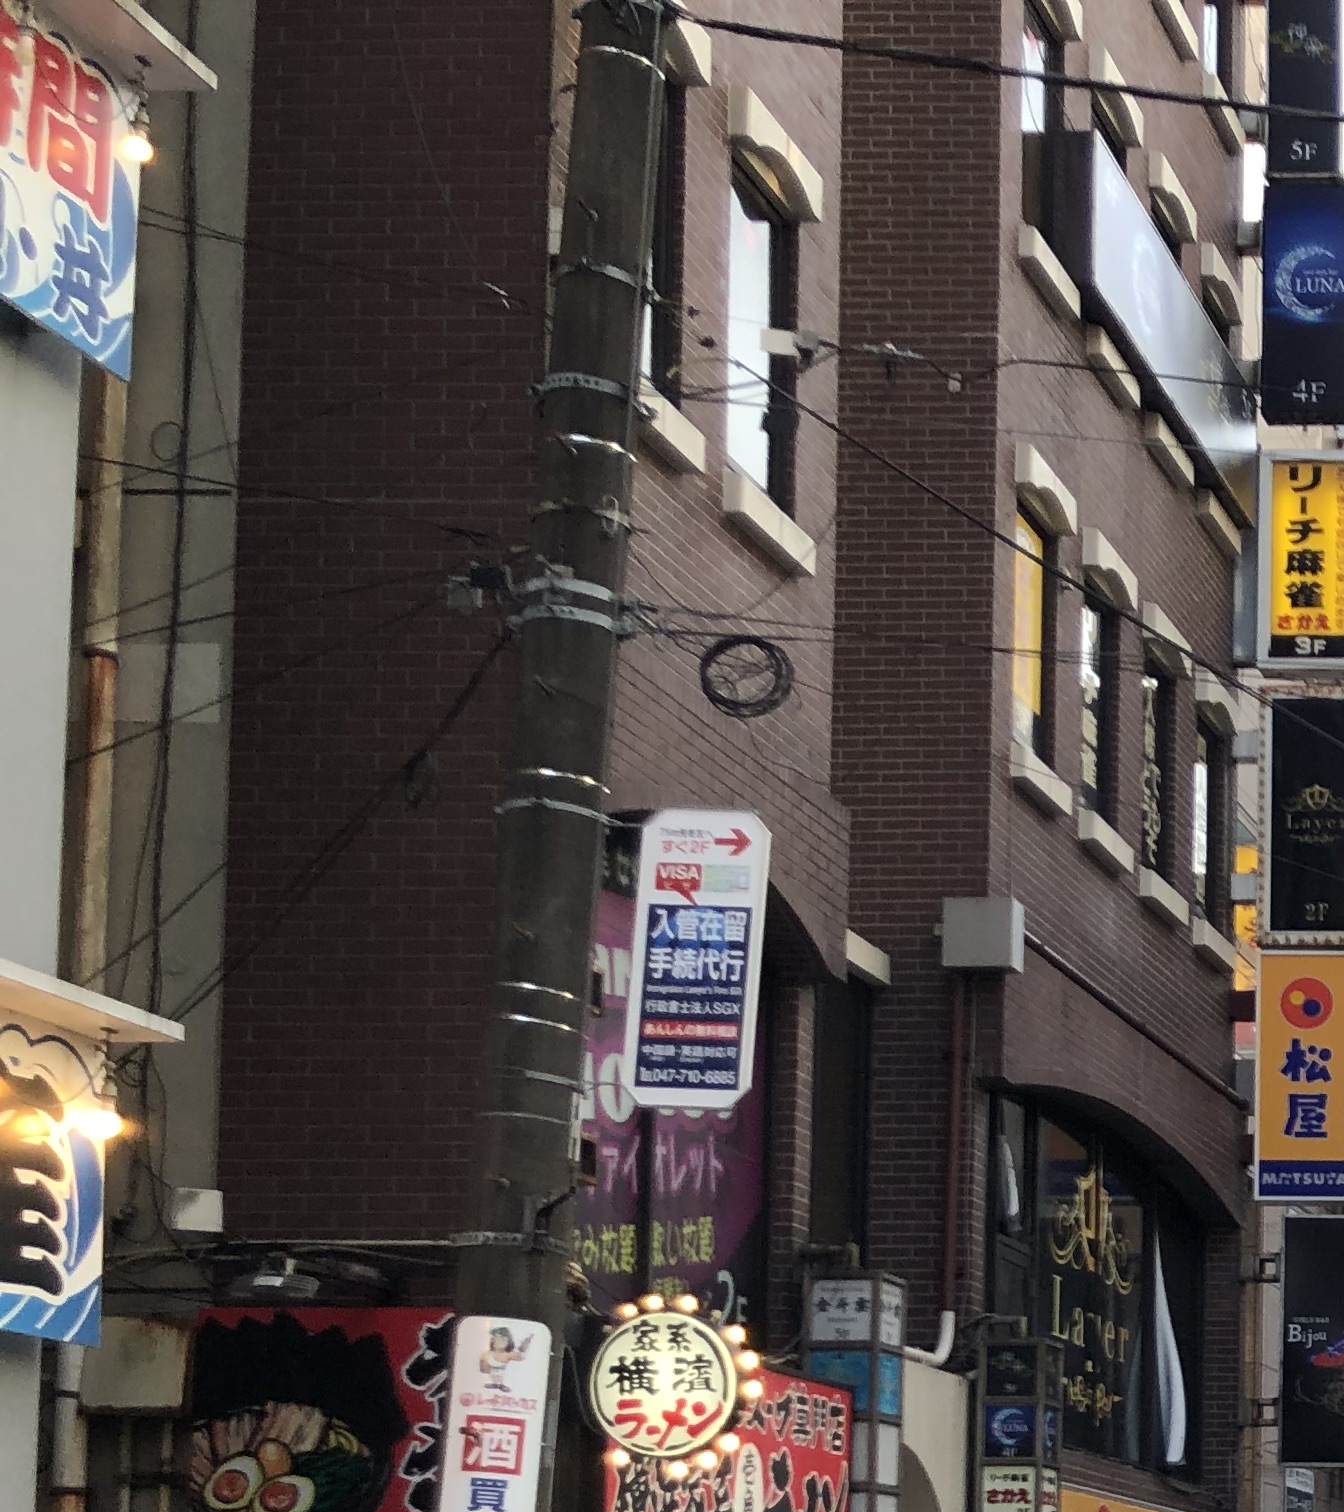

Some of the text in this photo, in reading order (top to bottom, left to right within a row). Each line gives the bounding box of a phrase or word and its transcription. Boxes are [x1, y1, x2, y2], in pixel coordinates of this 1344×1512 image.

[1290, 140, 1318, 162] 5F
[1293, 379, 1327, 403] 4F
[1286, 465, 1325, 608] リーチ麻雀
[1294, 636, 1327, 655] 3F
[660, 865, 700, 880] VISA
[650, 907, 748, 943] 入管在留
[648, 947, 745, 981] 手続代行
[1281, 1037, 1333, 1139] 松屋
[631, 1319, 692, 1351] 家系
[1288, 1324, 1327, 1349] Bijou
[614, 1398, 723, 1449] ラーメン
[466, 1421, 521, 1470] 酒
[987, 1488, 1031, 1504] さかえ
